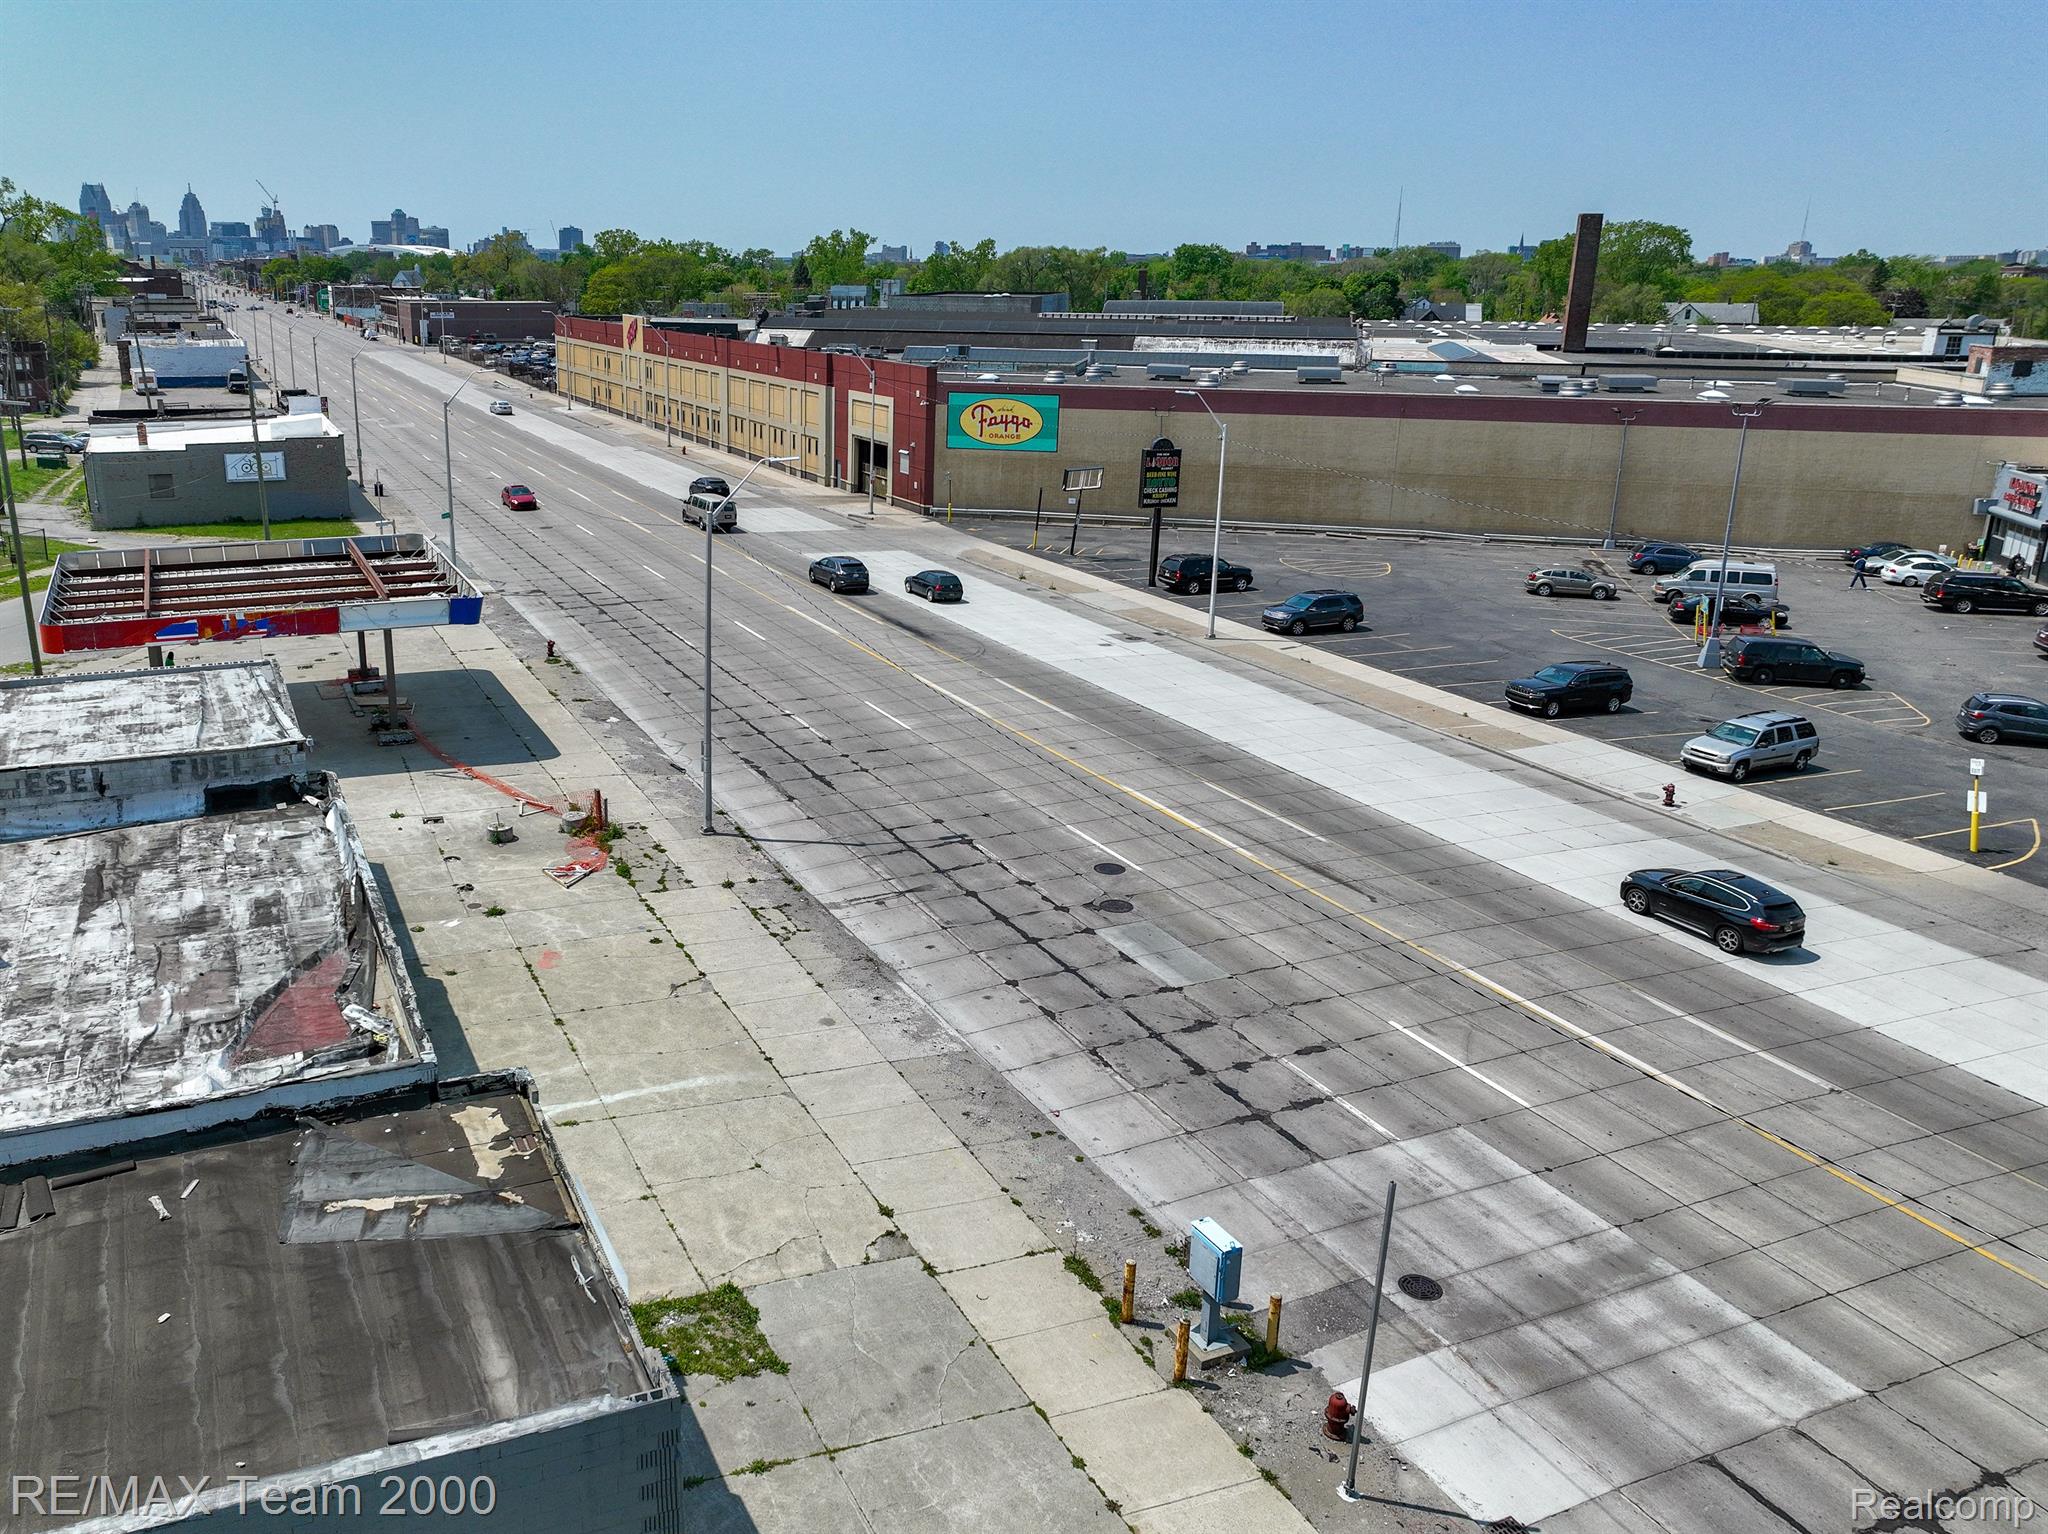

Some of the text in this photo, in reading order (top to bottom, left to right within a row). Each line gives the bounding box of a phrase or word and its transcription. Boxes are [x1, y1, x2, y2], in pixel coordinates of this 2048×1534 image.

[971, 404, 1033, 437] Faygo
[988, 432, 1021, 440] ORANGE
[1146, 456, 1179, 468] LIQUOR
[1147, 479, 1176, 487] LOTTO
[170, 753, 249, 784] FUEL
